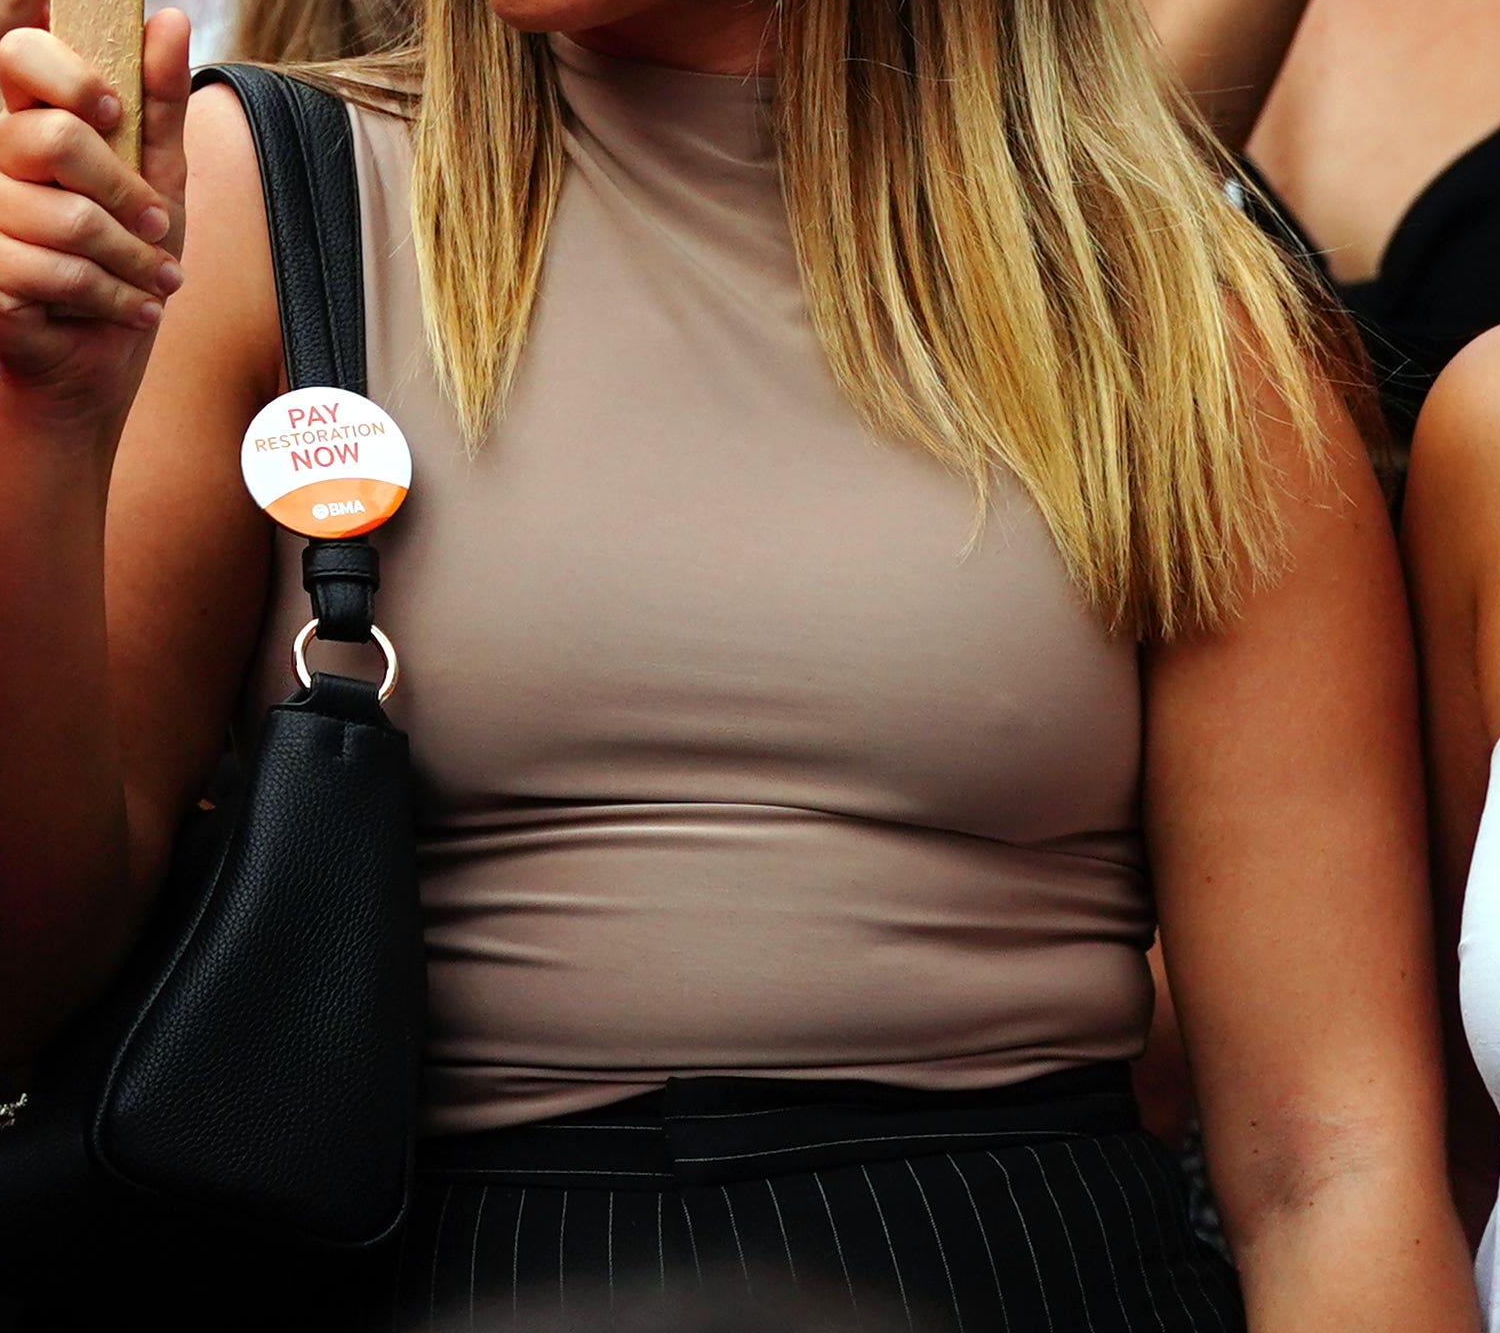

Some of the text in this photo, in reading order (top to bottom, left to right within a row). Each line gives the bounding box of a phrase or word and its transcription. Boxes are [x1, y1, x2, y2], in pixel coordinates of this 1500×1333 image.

[288, 403, 339, 429] PAY
[255, 422, 386, 452] RESTORATION
[291, 442, 359, 471] NOW
[329, 499, 365, 517] BMA
